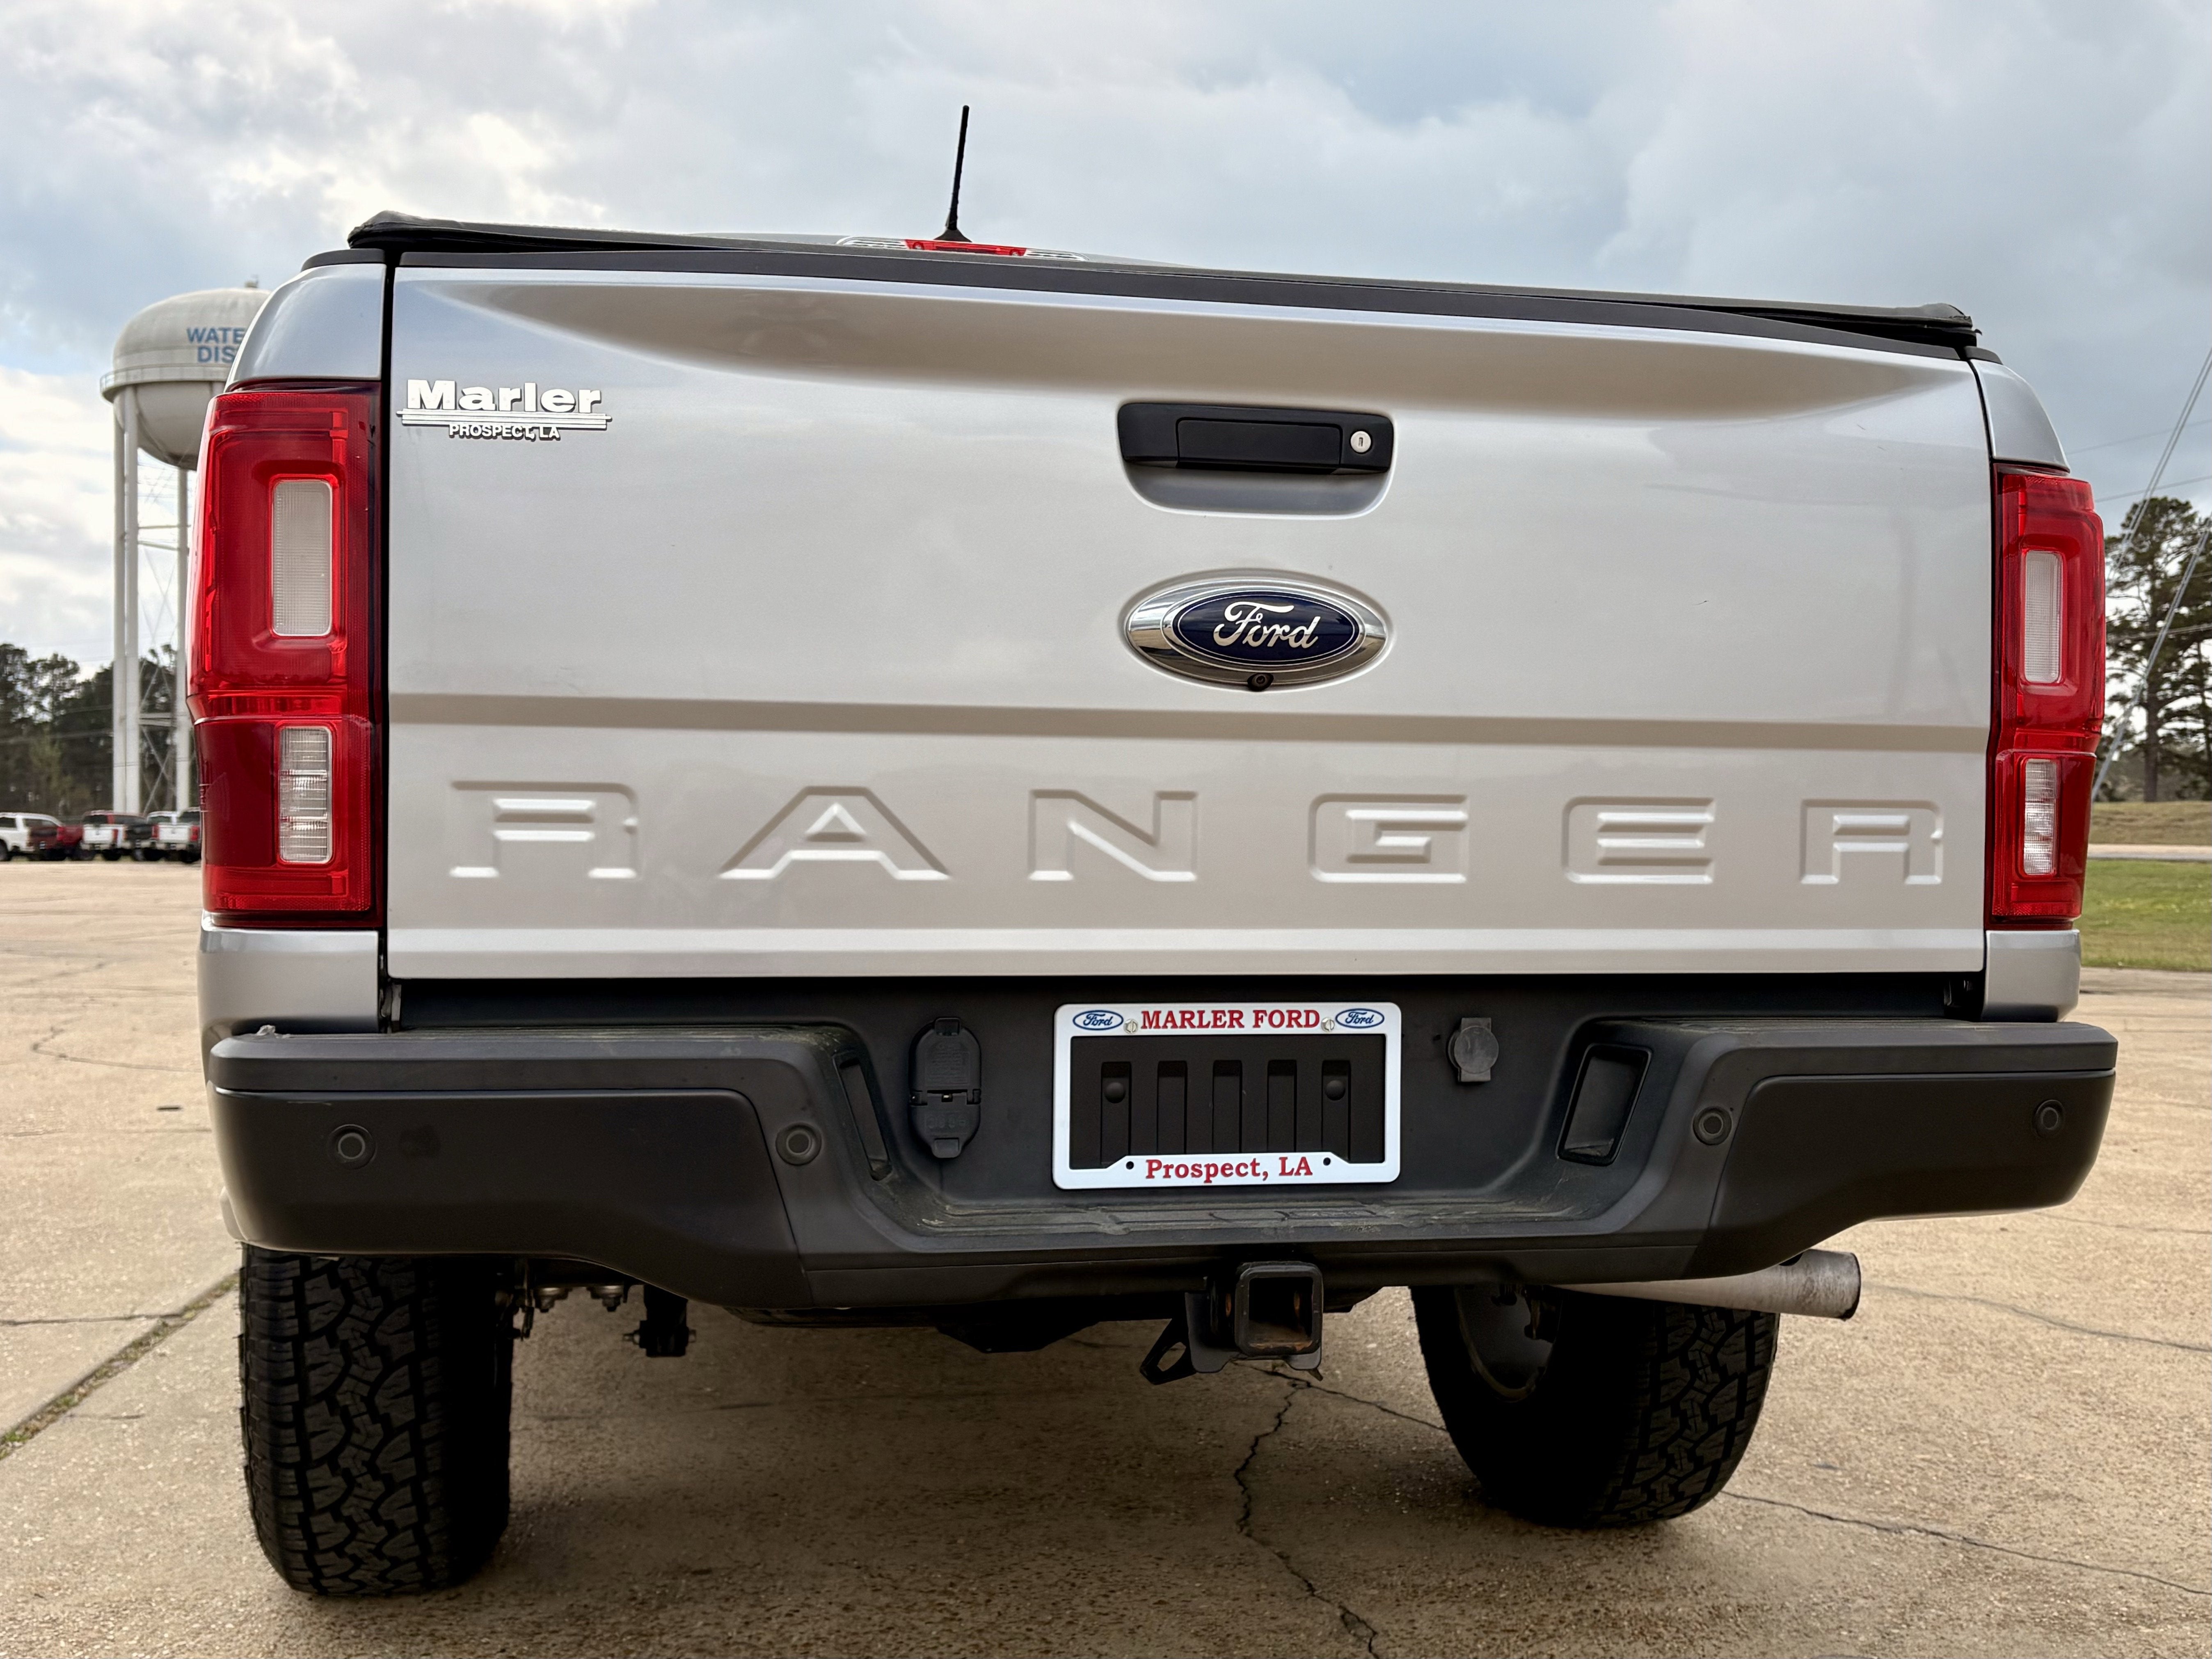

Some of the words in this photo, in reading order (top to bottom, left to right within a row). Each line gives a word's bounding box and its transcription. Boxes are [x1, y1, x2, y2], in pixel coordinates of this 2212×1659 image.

[197, 346, 238, 362] DIS
[407, 379, 602, 413] Marler
[448, 424, 535, 440] PROSPECT,
[539, 426, 561, 439] LA
[1213, 601, 1321, 648] Ford
[448, 780, 1945, 886] RANGER
[1083, 1013, 1114, 1026] Ford
[1141, 1010, 1244, 1029] MARLER
[1252, 1009, 1320, 1028] FORD
[1345, 1011, 1374, 1024] Ford
[1146, 1158, 1269, 1183] Prospect,
[1279, 1156, 1313, 1176] LA
